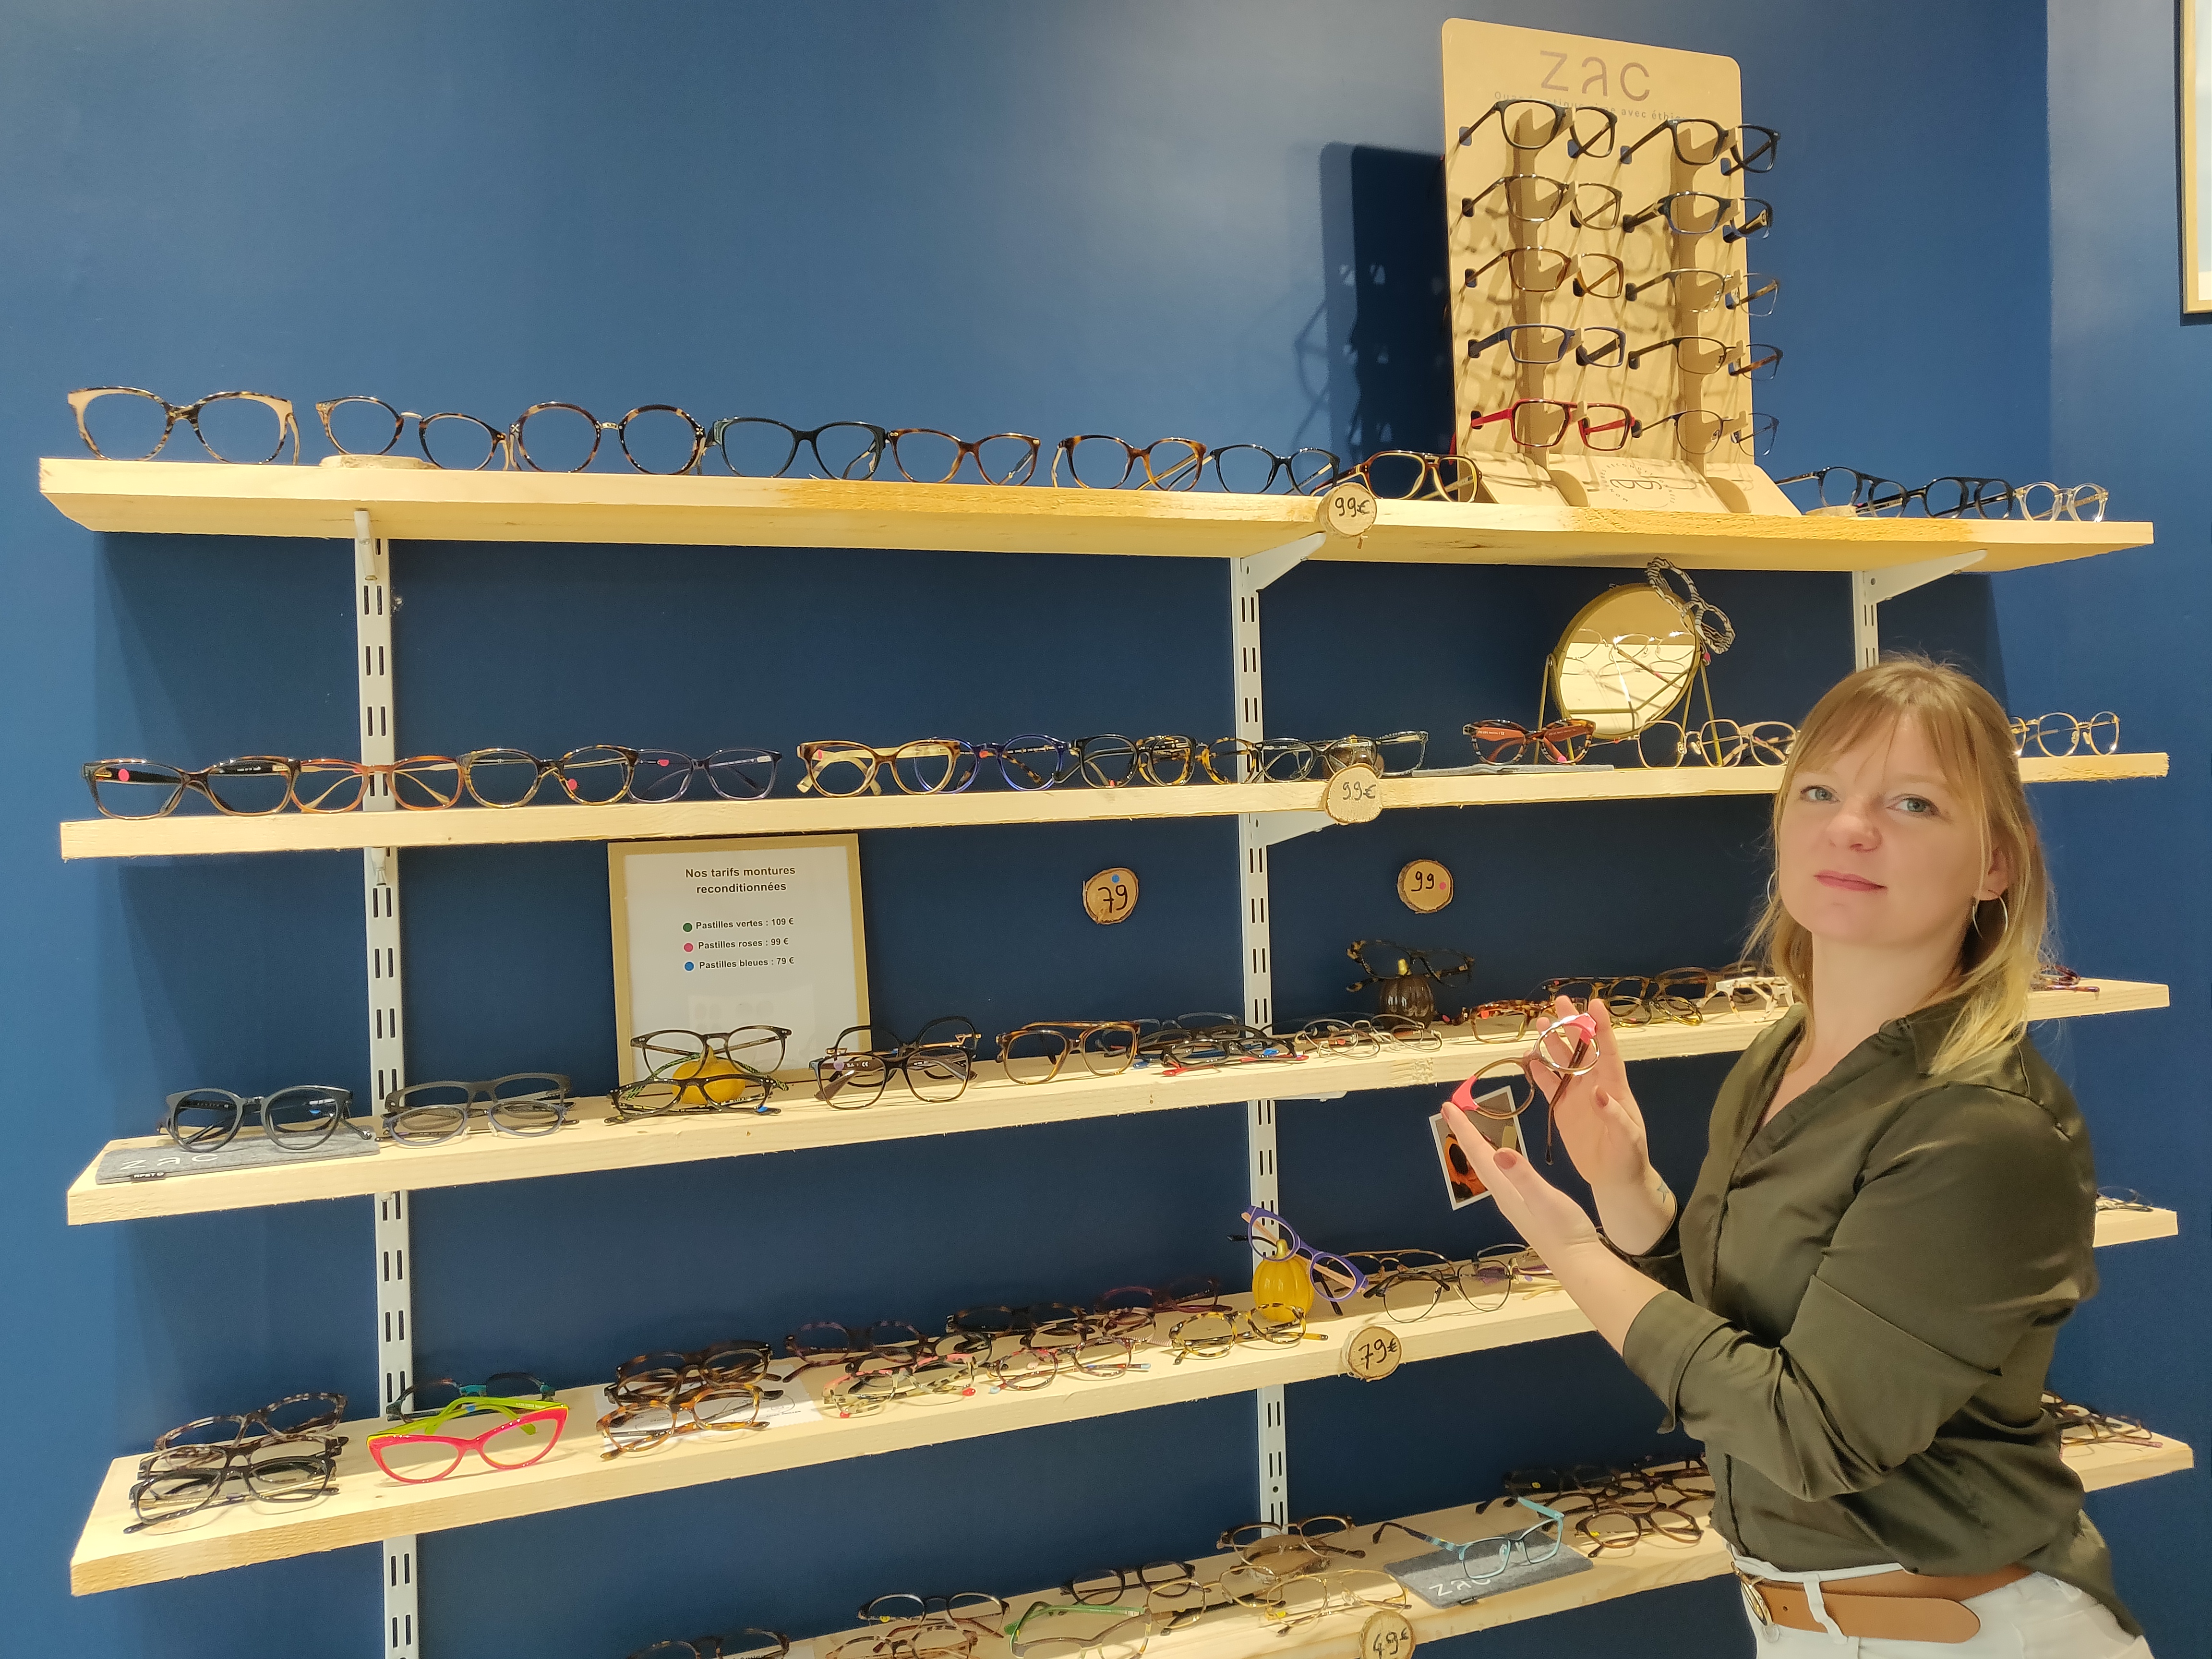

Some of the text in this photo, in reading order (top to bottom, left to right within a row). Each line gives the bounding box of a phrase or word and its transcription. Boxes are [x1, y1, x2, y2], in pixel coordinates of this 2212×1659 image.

[1622, 108, 1646, 118] avec
[1335, 497, 1370, 517] 99€
[1342, 781, 1376, 801] 99€
[685, 866, 796, 878] Nos tarifs montures
[697, 882, 787, 894] reconditionnées
[1411, 871, 1435, 892] 99
[1098, 884, 1128, 914] 79
[696, 921, 733, 929] Pastilles
[771, 918, 786, 926] 109
[698, 940, 736, 949] Pastilles
[699, 960, 737, 969] Pastilles
[739, 959, 769, 967] bleues
[1358, 1337, 1398, 1370] 79€
[1373, 1627, 1409, 1659] 49€
